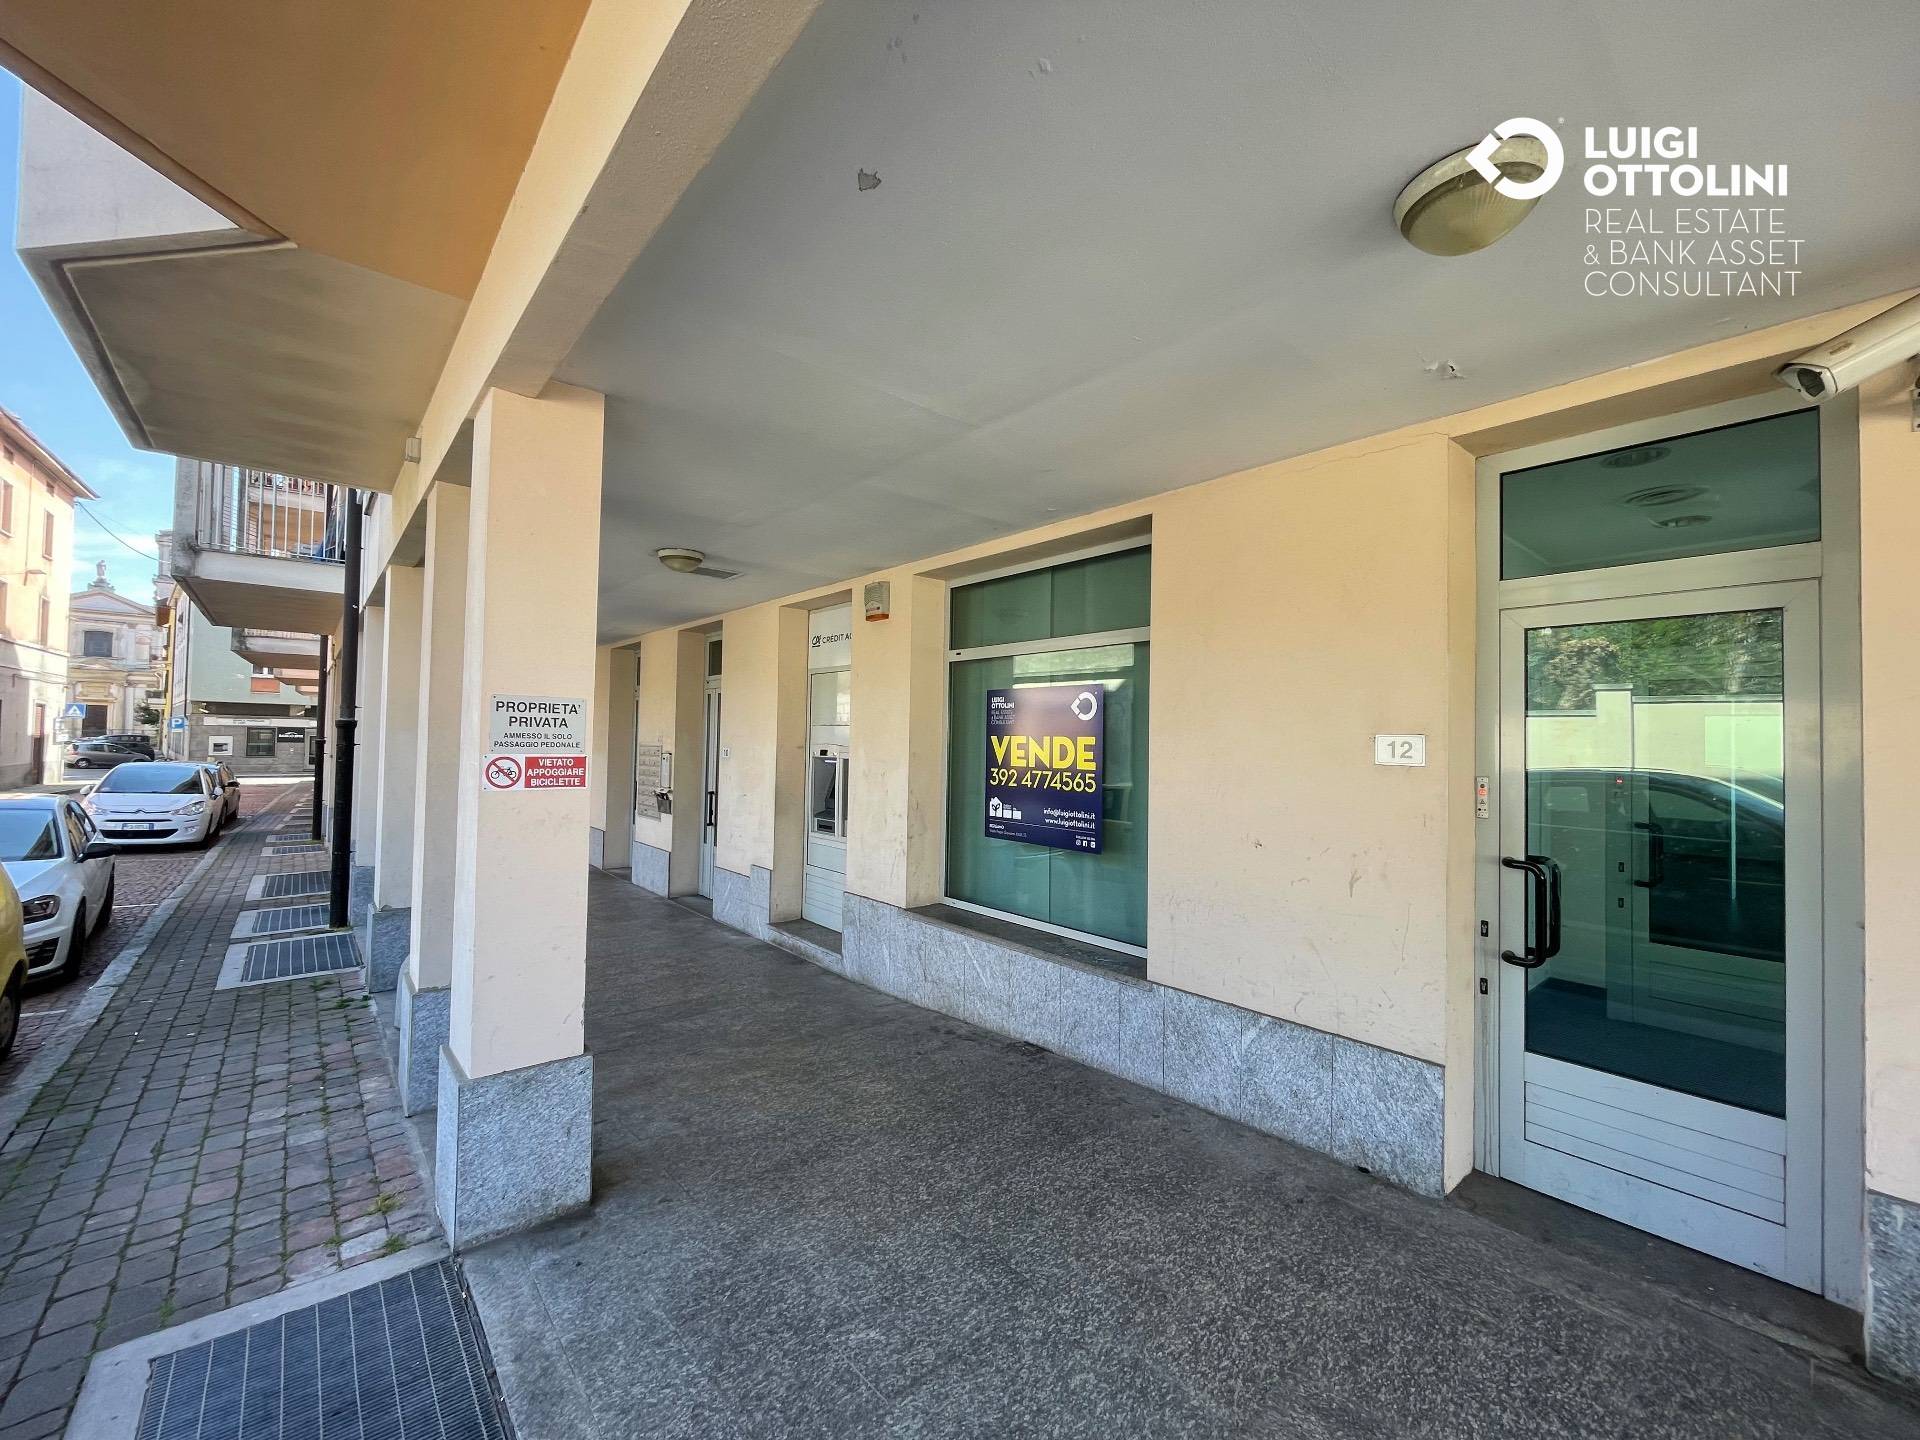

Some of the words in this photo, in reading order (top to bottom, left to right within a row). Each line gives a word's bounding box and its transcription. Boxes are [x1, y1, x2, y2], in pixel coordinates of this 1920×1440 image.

[495, 701, 581, 715] PROPRIETA'
[508, 716, 569, 728] PRIVATA
[503, 732, 542, 740] AMMESSO
[493, 740, 539, 748] PASSAGGIO
[540, 741, 581, 749] PEDONALE
[1387, 740, 1413, 759] 12
[990, 735, 1097, 770] VENDE
[538, 758, 574, 767] VIETATO
[526, 768, 585, 777] APPOGGIARE
[530, 778, 581, 787] BICICLETTE
[989, 768, 1018, 787] 392
[1021, 770, 1097, 793] 4774565
[1043, 807, 1096, 820] info@luigiottolini.it
[1044, 817, 1096, 830] www.luigiottolini.it
